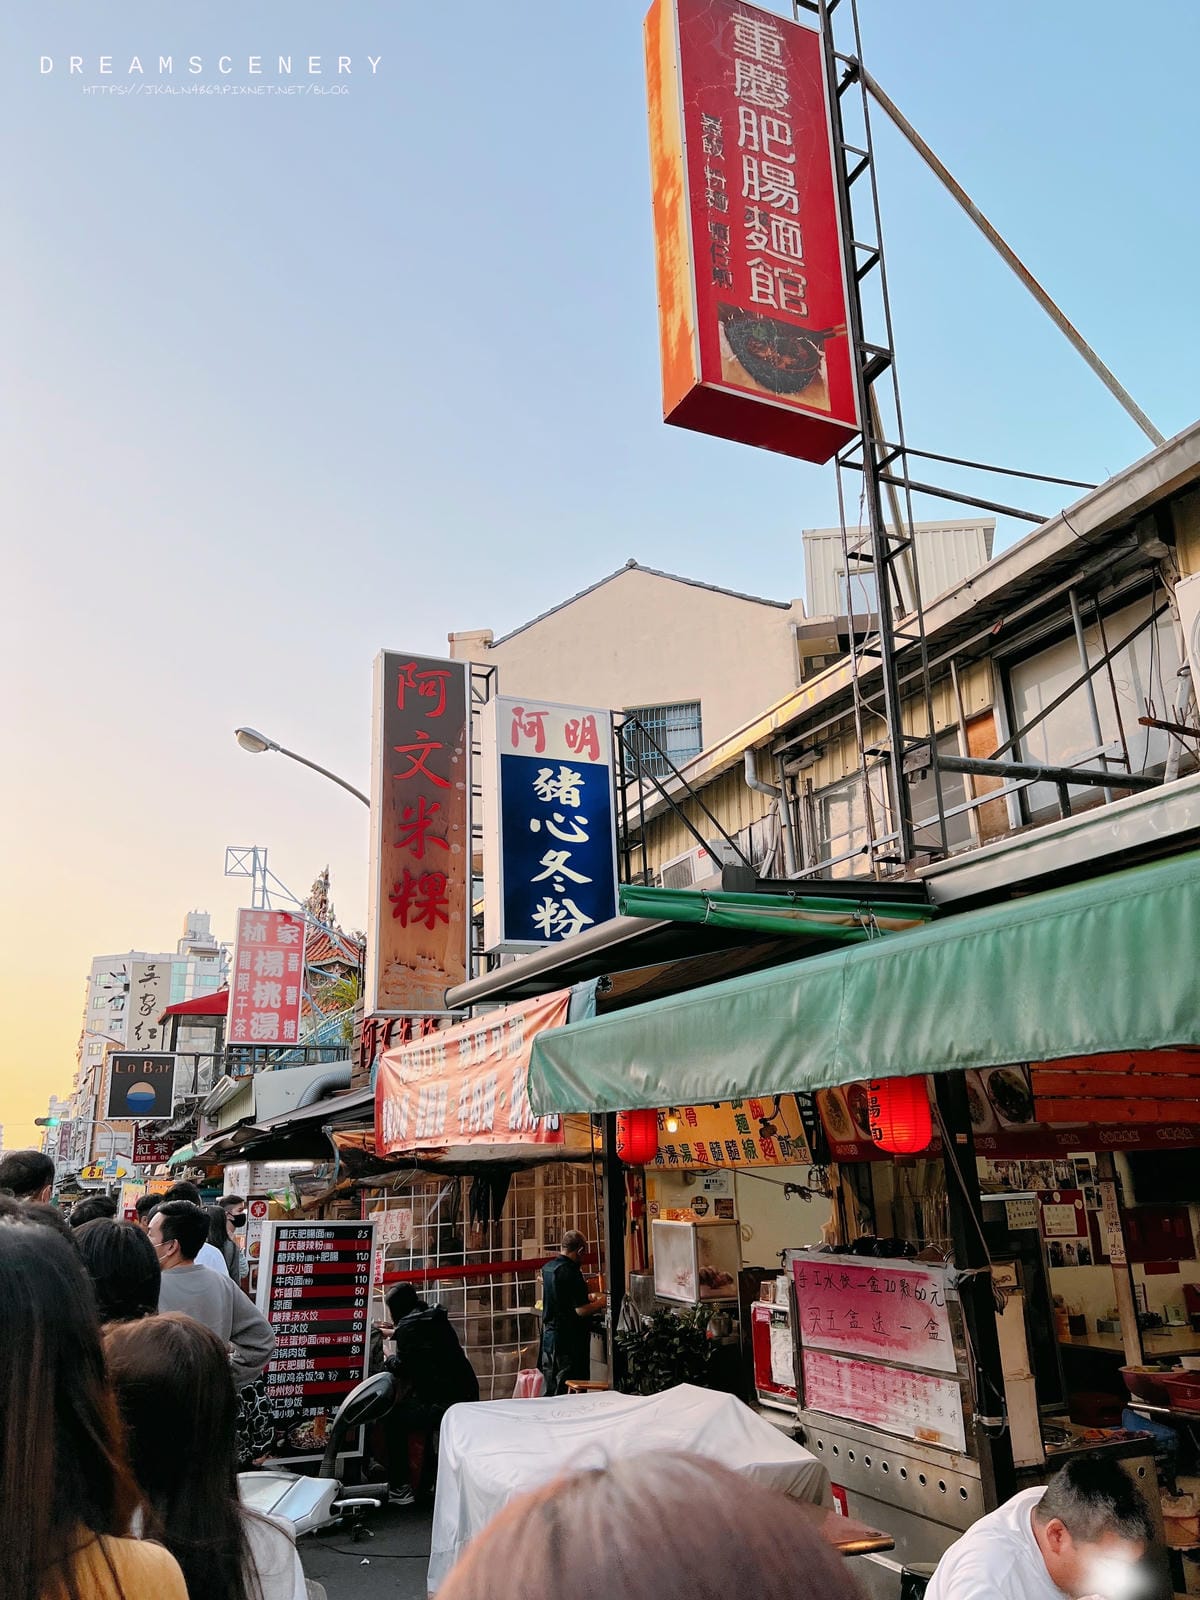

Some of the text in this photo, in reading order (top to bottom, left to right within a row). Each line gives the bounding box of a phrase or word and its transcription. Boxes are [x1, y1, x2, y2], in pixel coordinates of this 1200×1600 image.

[732, 12, 809, 317] 重慶肥腸麵館
[511, 706, 601, 762] 阿明
[389, 661, 451, 930] 阿文米粿
[530, 765, 595, 939] 豬心冬粉
[242, 921, 300, 944] 林家
[250, 950, 285, 1040] 楊桃湯
[136, 1143, 169, 1155] 紅茶
[276, 1263, 314, 1275] 重庆小面
[354, 1275, 368, 1285] 110
[272, 1323, 309, 1335] 手工水饺
[349, 1369, 360, 1379] 75
